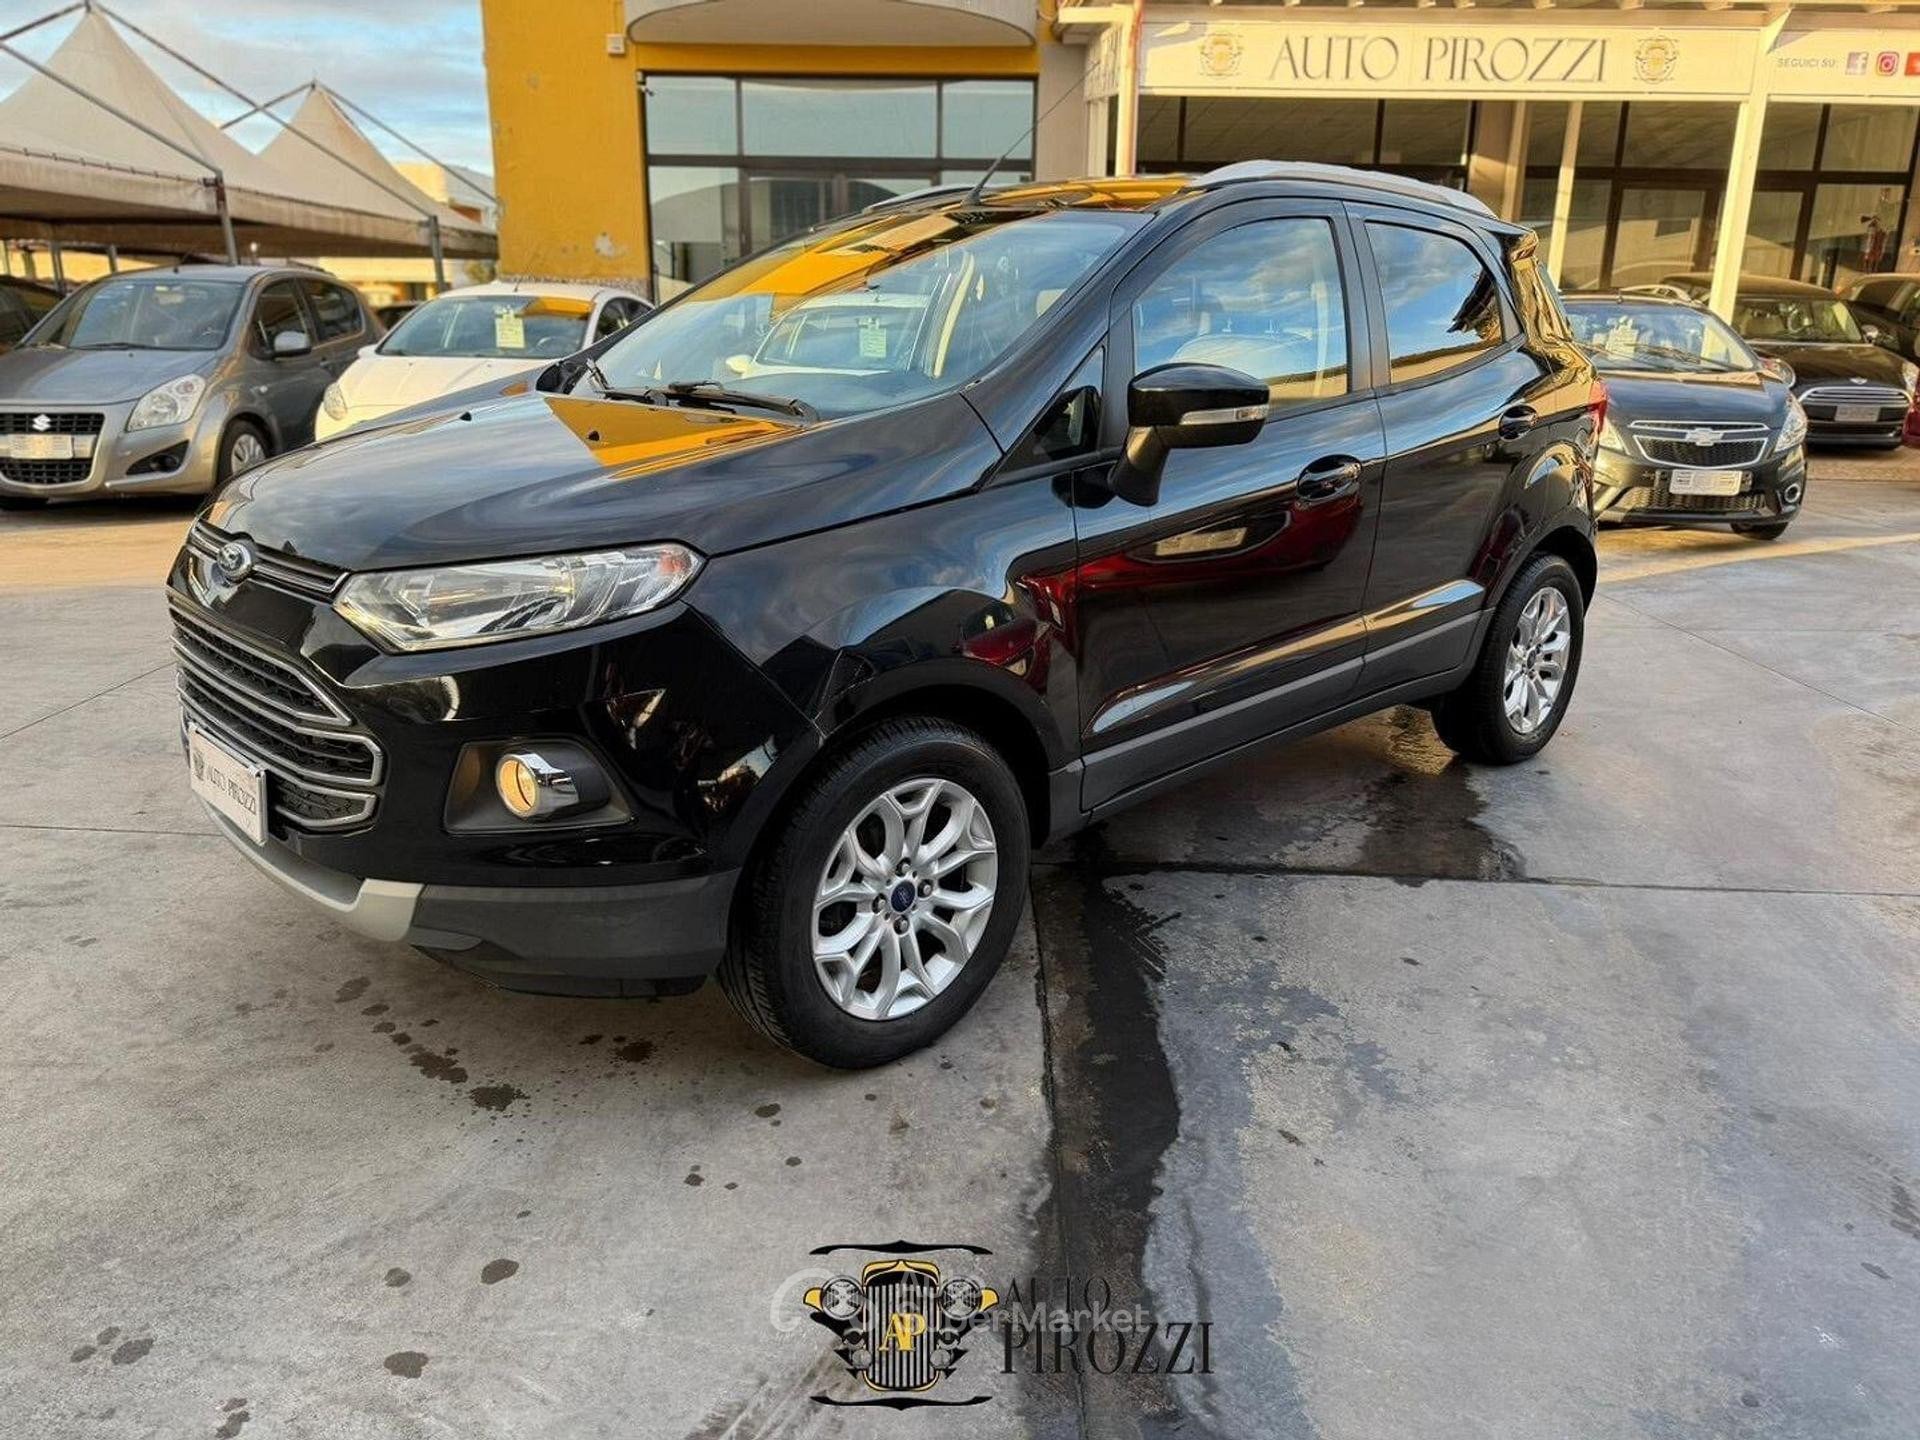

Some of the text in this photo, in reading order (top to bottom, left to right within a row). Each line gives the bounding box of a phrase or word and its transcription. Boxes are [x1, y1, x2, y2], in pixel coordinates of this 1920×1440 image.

[1270, 35, 1609, 83] AUTO PIROZZI
[1776, 57, 1819, 69] SEGUICI
